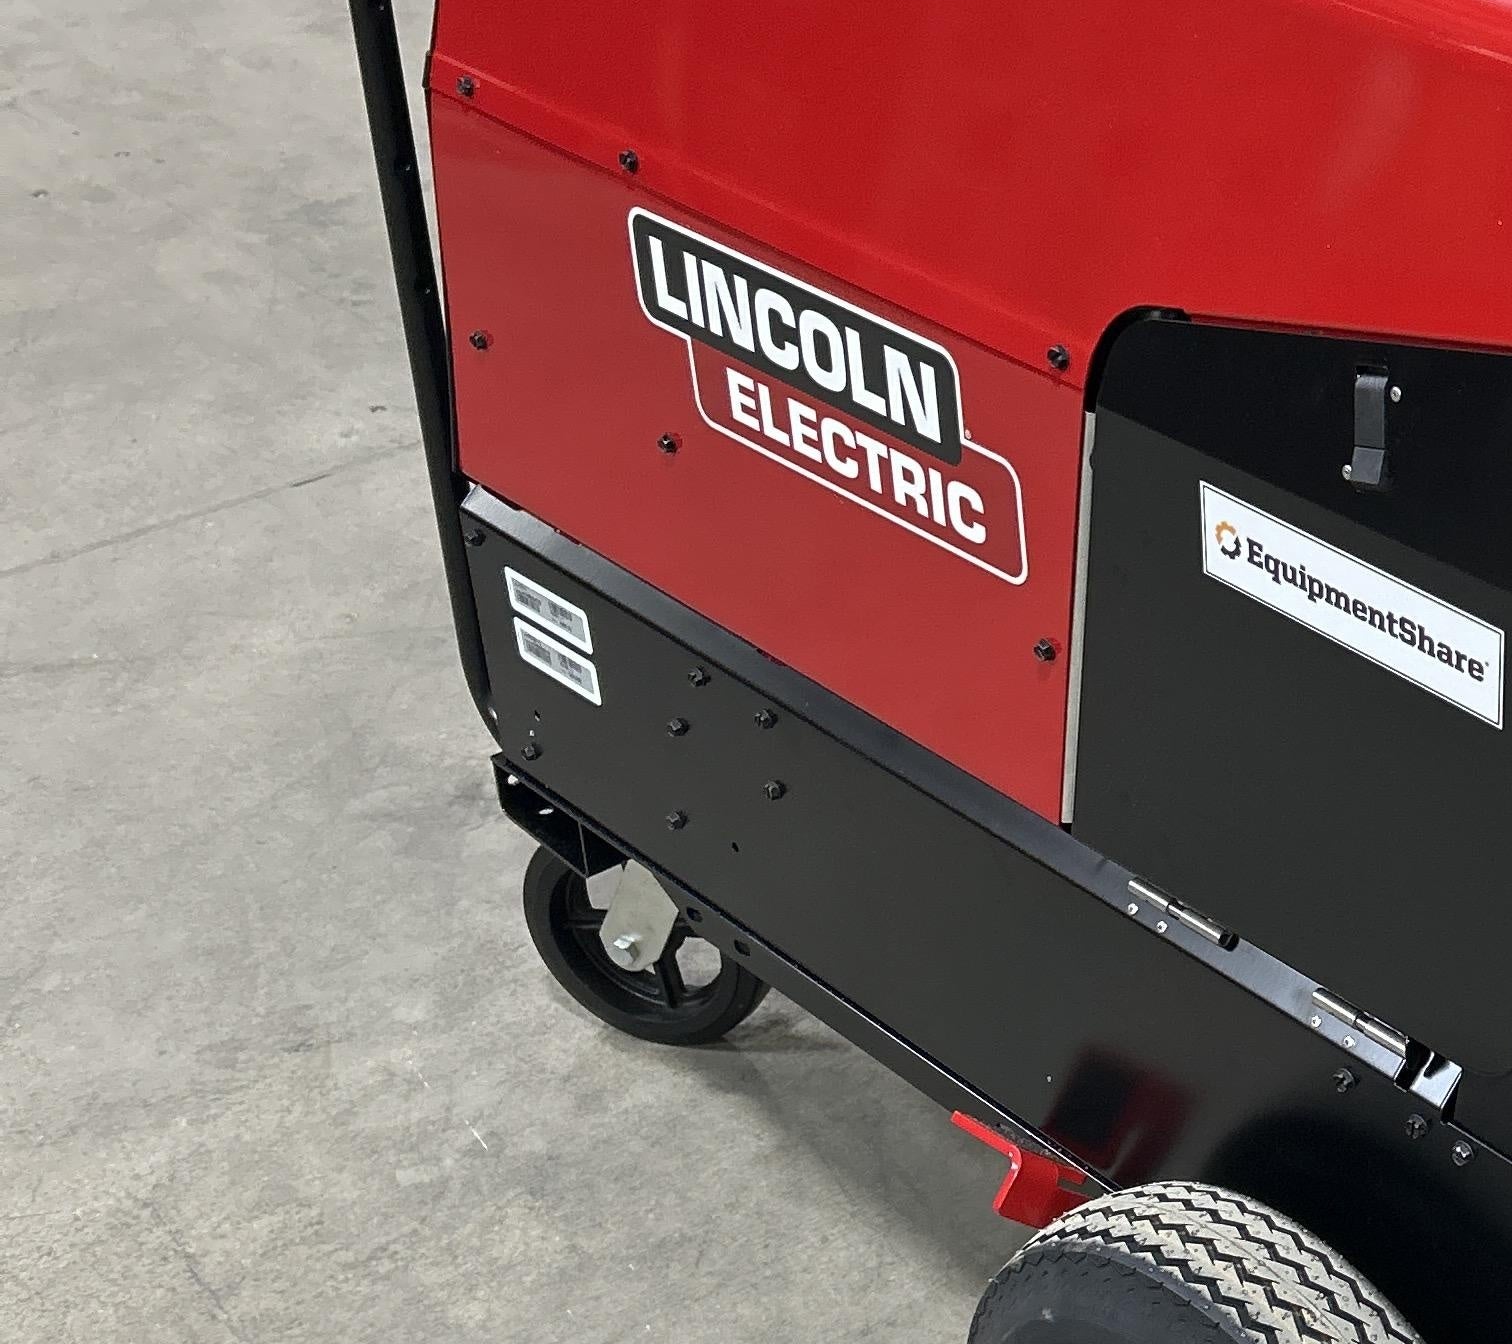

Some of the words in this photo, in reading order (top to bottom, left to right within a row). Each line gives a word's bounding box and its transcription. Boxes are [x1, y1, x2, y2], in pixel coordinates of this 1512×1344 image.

[648, 234, 943, 444] LINCOLN
[725, 367, 986, 545] ELECTRIC
[1246, 536, 1487, 683] EquipmentShare
